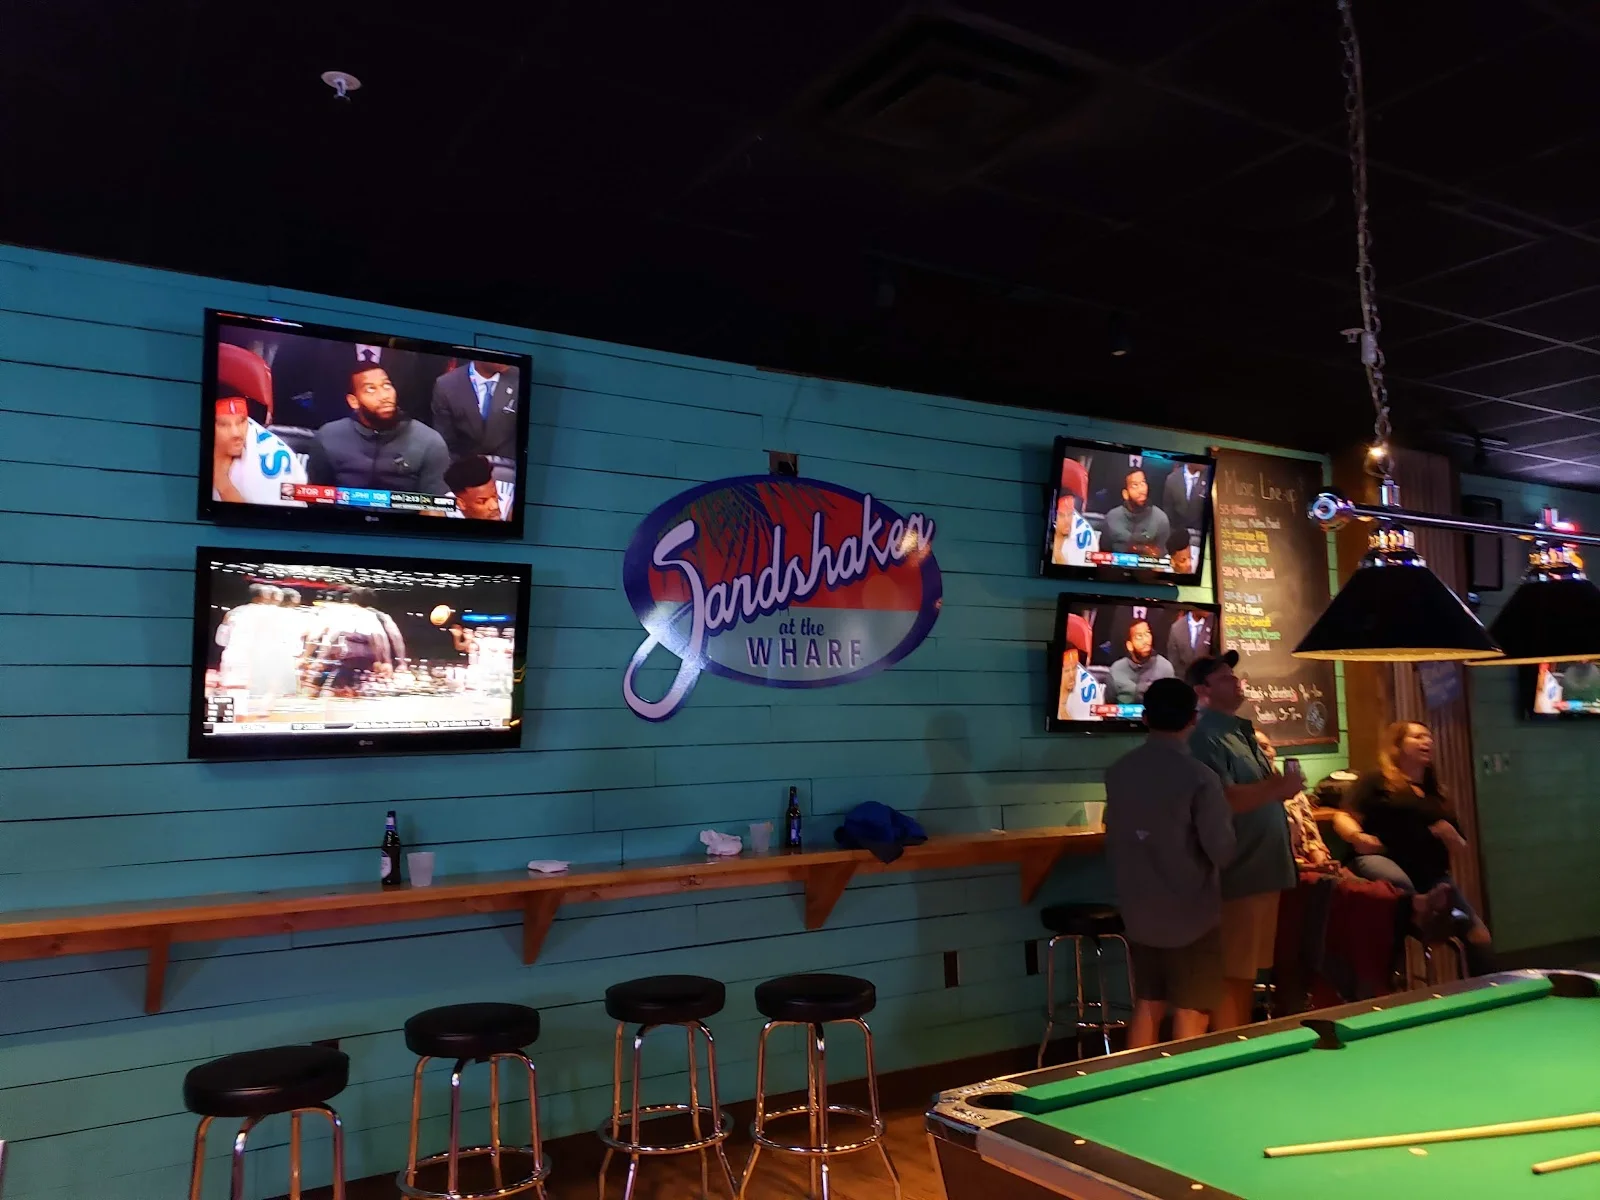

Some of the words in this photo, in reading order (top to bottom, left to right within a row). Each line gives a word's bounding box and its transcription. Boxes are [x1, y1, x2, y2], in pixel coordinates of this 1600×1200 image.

[301, 487, 318, 496] TOR
[778, 619, 797, 636] at
[800, 617, 825, 637] the
[745, 637, 863, 669] WHARF
